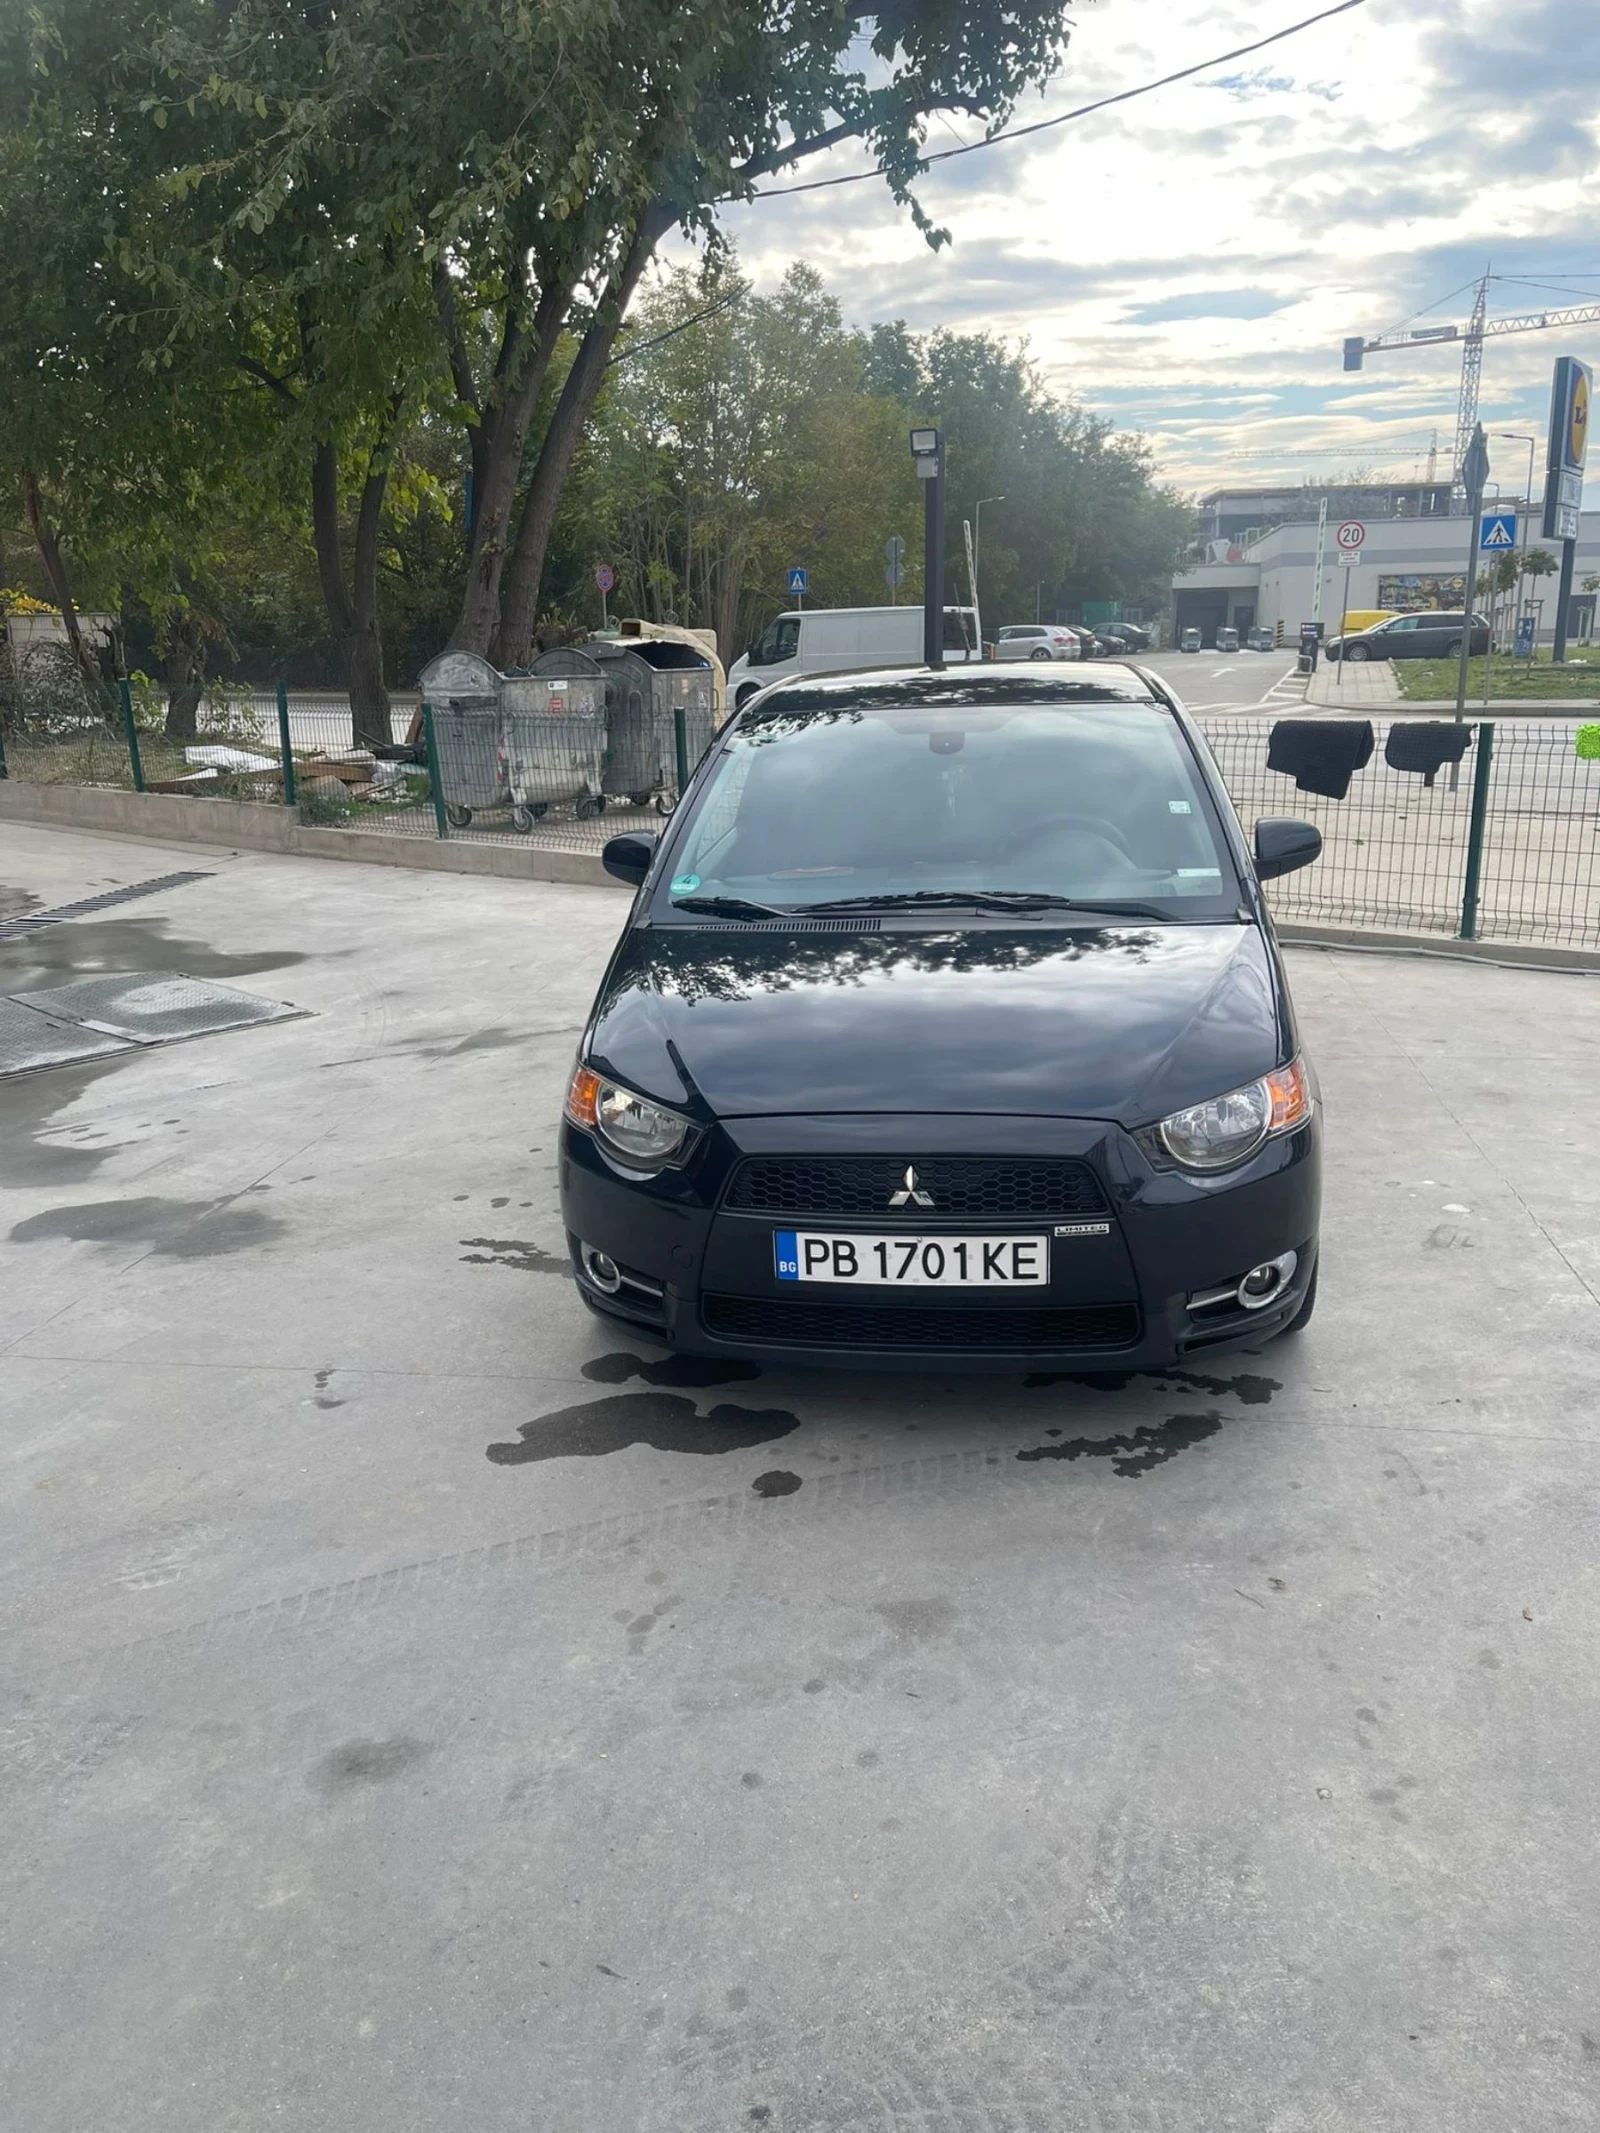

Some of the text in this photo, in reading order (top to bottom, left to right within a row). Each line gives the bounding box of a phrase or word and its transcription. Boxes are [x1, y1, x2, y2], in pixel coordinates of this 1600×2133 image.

[1343, 528, 1360, 542] 20
[804, 1238, 1039, 1280] PB 1701 KE
[779, 1261, 797, 1272] BG
